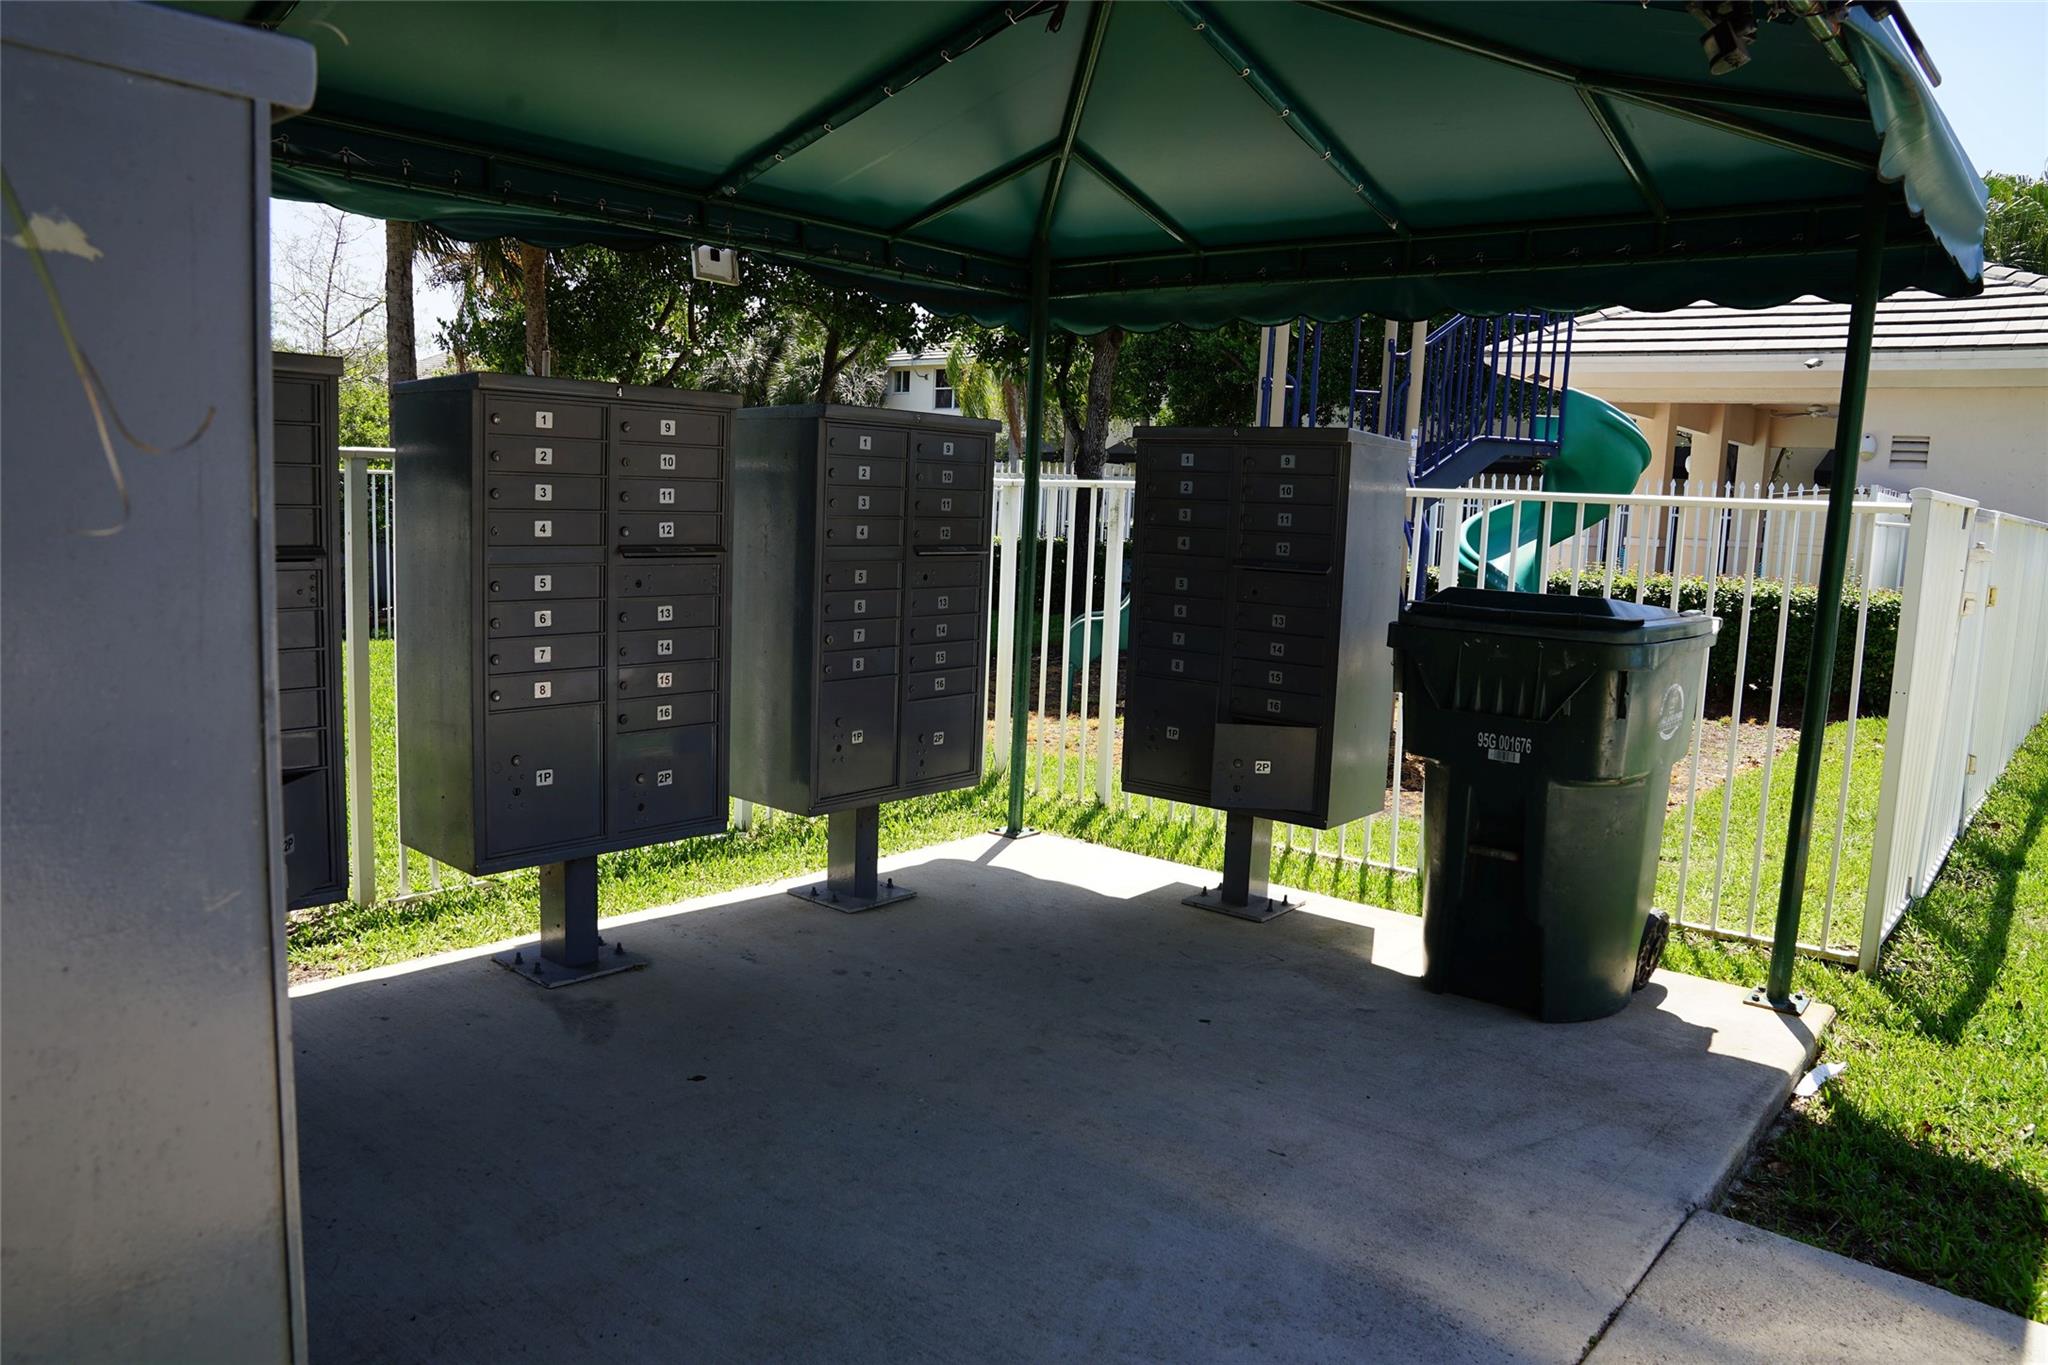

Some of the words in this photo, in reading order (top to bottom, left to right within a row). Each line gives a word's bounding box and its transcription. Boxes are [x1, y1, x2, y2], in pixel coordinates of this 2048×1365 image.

[616, 387, 622, 397] 4
[541, 414, 547, 425] 1
[664, 422, 671, 433] 9
[945, 444, 951, 454] 9
[540, 450, 547, 462] 2
[1284, 456, 1291, 466] 9
[662, 456, 674, 467] 10
[861, 468, 867, 478] 2
[943, 472, 952, 481] 10
[1183, 482, 1190, 492] 2
[1281, 486, 1292, 496] 10
[540, 487, 547, 498] 3
[661, 490, 672, 501] 11
[861, 498, 867, 508] 3
[942, 500, 950, 509] 11
[1279, 515, 1289, 524] 11
[539, 523, 547, 534] 4
[660, 524, 672, 535] 12
[859, 527, 865, 537] 4
[941, 528, 950, 538] 12
[1180, 538, 1187, 548] 4
[1278, 544, 1289, 554] 12
[858, 572, 864, 582] 5
[539, 577, 547, 589] 5
[857, 601, 863, 612] 6
[939, 598, 948, 607] 13
[539, 613, 547, 624] 6
[659, 608, 671, 619] 13
[1274, 616, 1284, 626] 13
[856, 630, 862, 640] 7
[938, 626, 946, 635] 14
[1175, 634, 1182, 643] 7
[659, 642, 671, 653] 14
[1272, 645, 1282, 654] 14
[539, 649, 546, 660] 7
[936, 652, 945, 662] 15
[855, 660, 861, 670] 8
[659, 675, 671, 685] 15
[1270, 672, 1281, 682] 15
[936, 679, 944, 688] 16
[539, 684, 546, 696] 8
[1269, 701, 1280, 711] 16
[659, 707, 671, 718] 16
[852, 732, 863, 742] 1P
[1168, 728, 1178, 737] 1P
[933, 734, 943, 743] 2P
[1477, 732, 1496, 748] 95G
[1498, 734, 1532, 754] 001676
[1256, 762, 1270, 772] 2P
[537, 772, 552, 783] 1P
[658, 772, 672, 784] 2P
